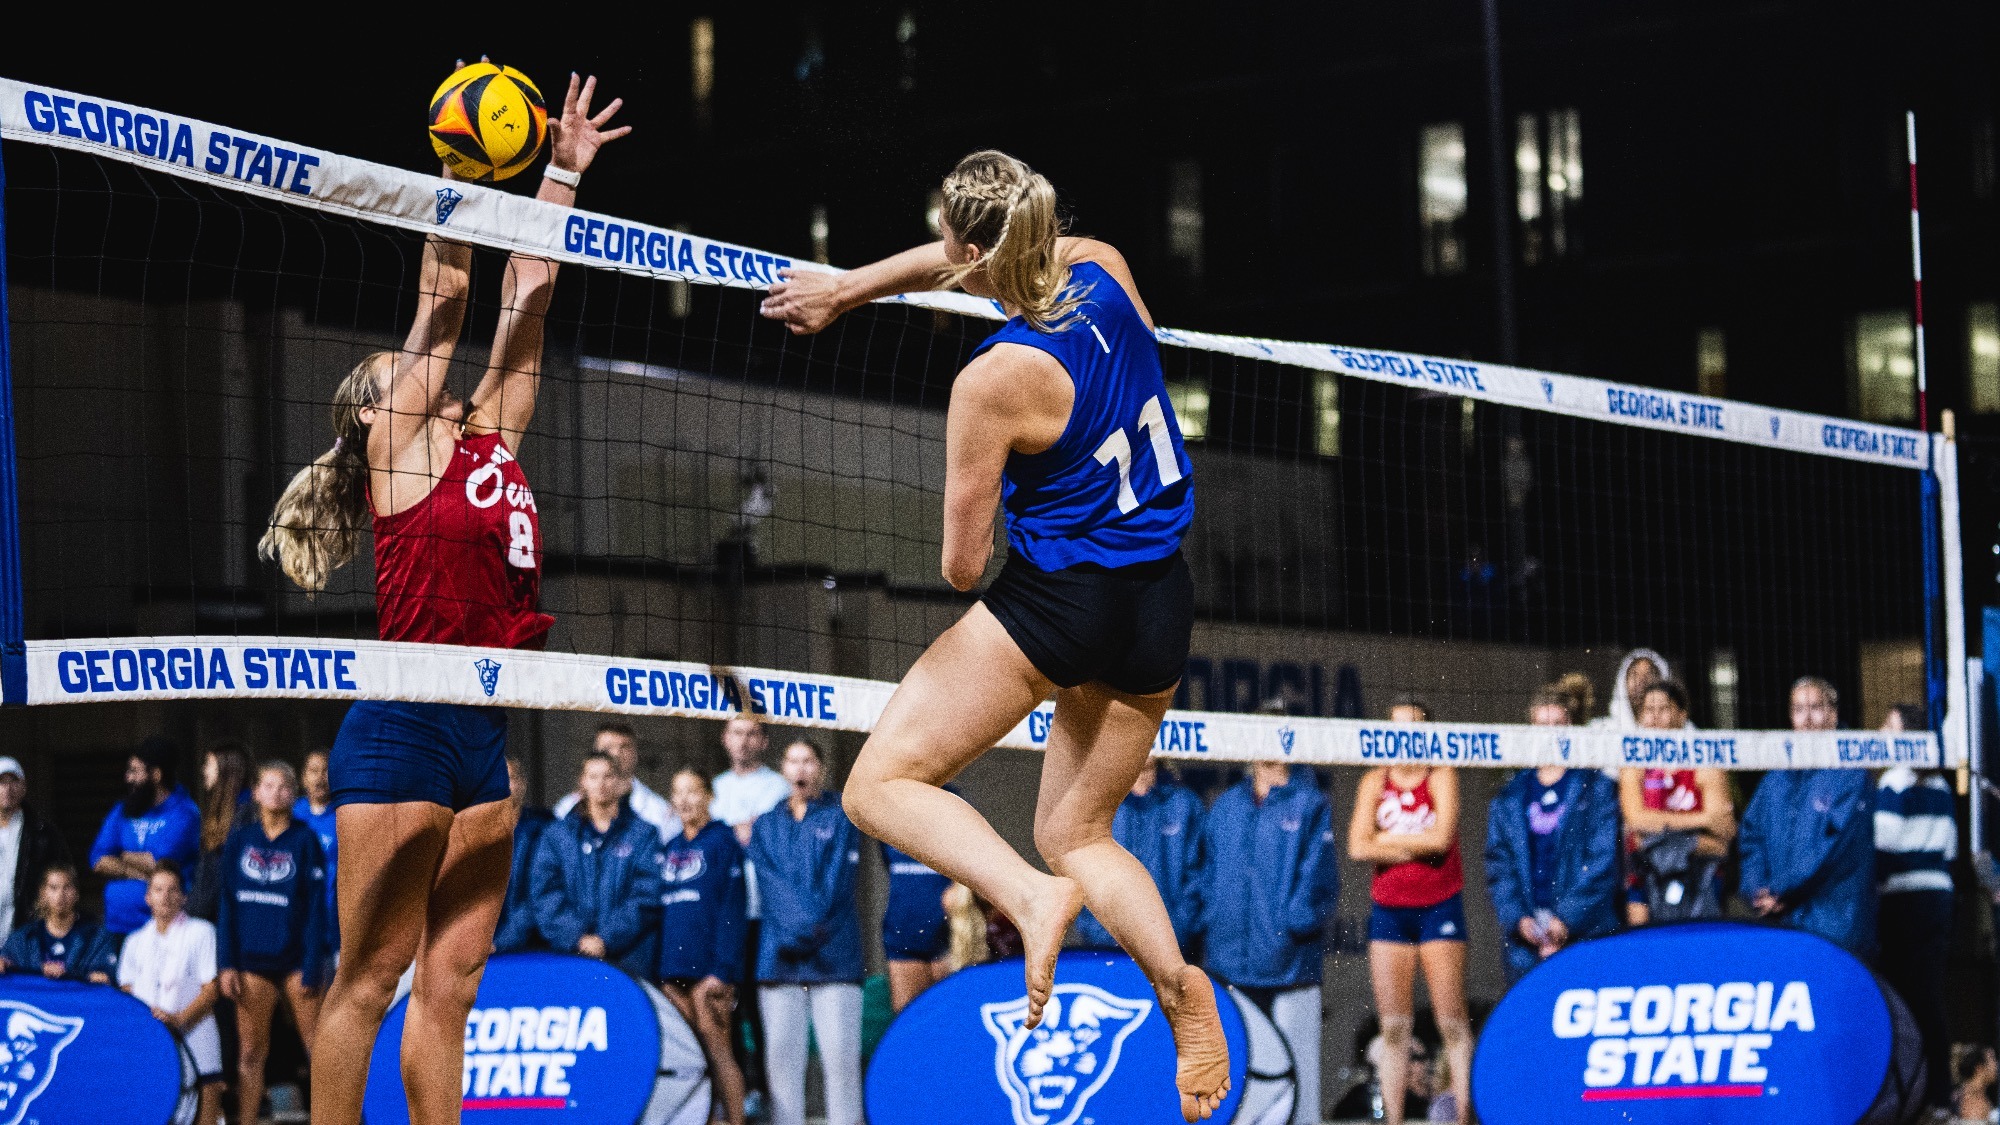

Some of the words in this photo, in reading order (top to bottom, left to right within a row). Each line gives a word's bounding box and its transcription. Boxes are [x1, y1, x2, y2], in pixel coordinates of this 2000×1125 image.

[491, 105, 509, 122] avp
[24, 90, 195, 168] GEORGIA
[205, 131, 320, 196] STATE
[564, 214, 701, 276] GEORGIA
[1423, 359, 1487, 392] STATE
[1607, 388, 1676, 423] GEORGIA
[1679, 400, 1725, 431] STATE
[1093, 395, 1182, 515] 11
[58, 647, 235, 694] GEORGIA
[243, 647, 357, 691] STATE
[605, 667, 743, 713] GEORGIA
[748, 677, 837, 721] STATE
[1152, 720, 1208, 752] TATE
[1359, 729, 1443, 760] GEORGIA
[1447, 731, 1502, 760] STATE
[1622, 736, 1690, 764] GEORGIA
[1693, 737, 1737, 764] STATE
[465, 1006, 608, 1052] EORGIA
[1552, 980, 1816, 1039] GEORGIA
[1583, 1033, 1773, 1088] STATE
